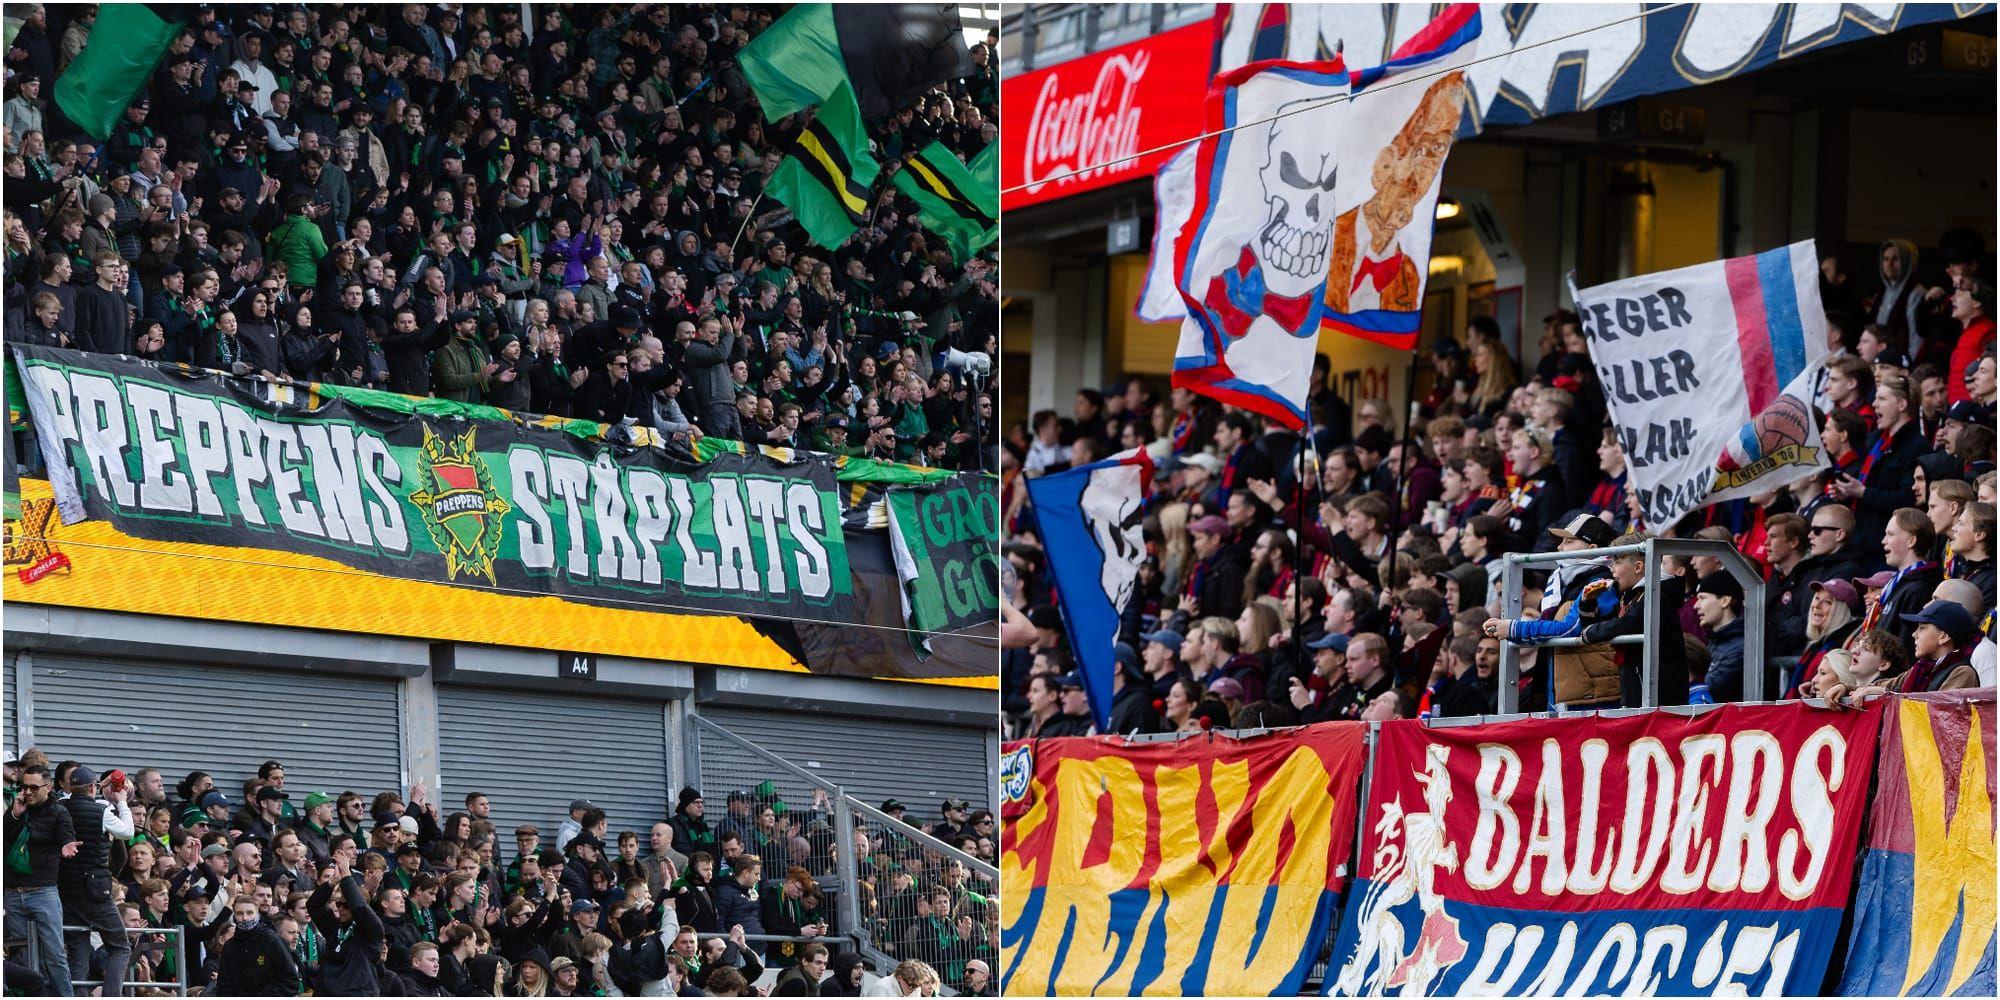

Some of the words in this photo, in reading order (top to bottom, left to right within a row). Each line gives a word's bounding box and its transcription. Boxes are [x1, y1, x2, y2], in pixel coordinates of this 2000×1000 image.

[1908, 42, 1926, 64] G5
[1964, 40, 1990, 67] G5
[1609, 109, 1626, 133] G4
[1660, 109, 1685, 134] G4
[27, 365, 410, 552] PREPPENS
[435, 494, 484, 516] PREPPENS
[507, 447, 832, 598] STÅPLATS
[572, 656, 588, 674] A4
[1463, 724, 1848, 900] BALDERS
